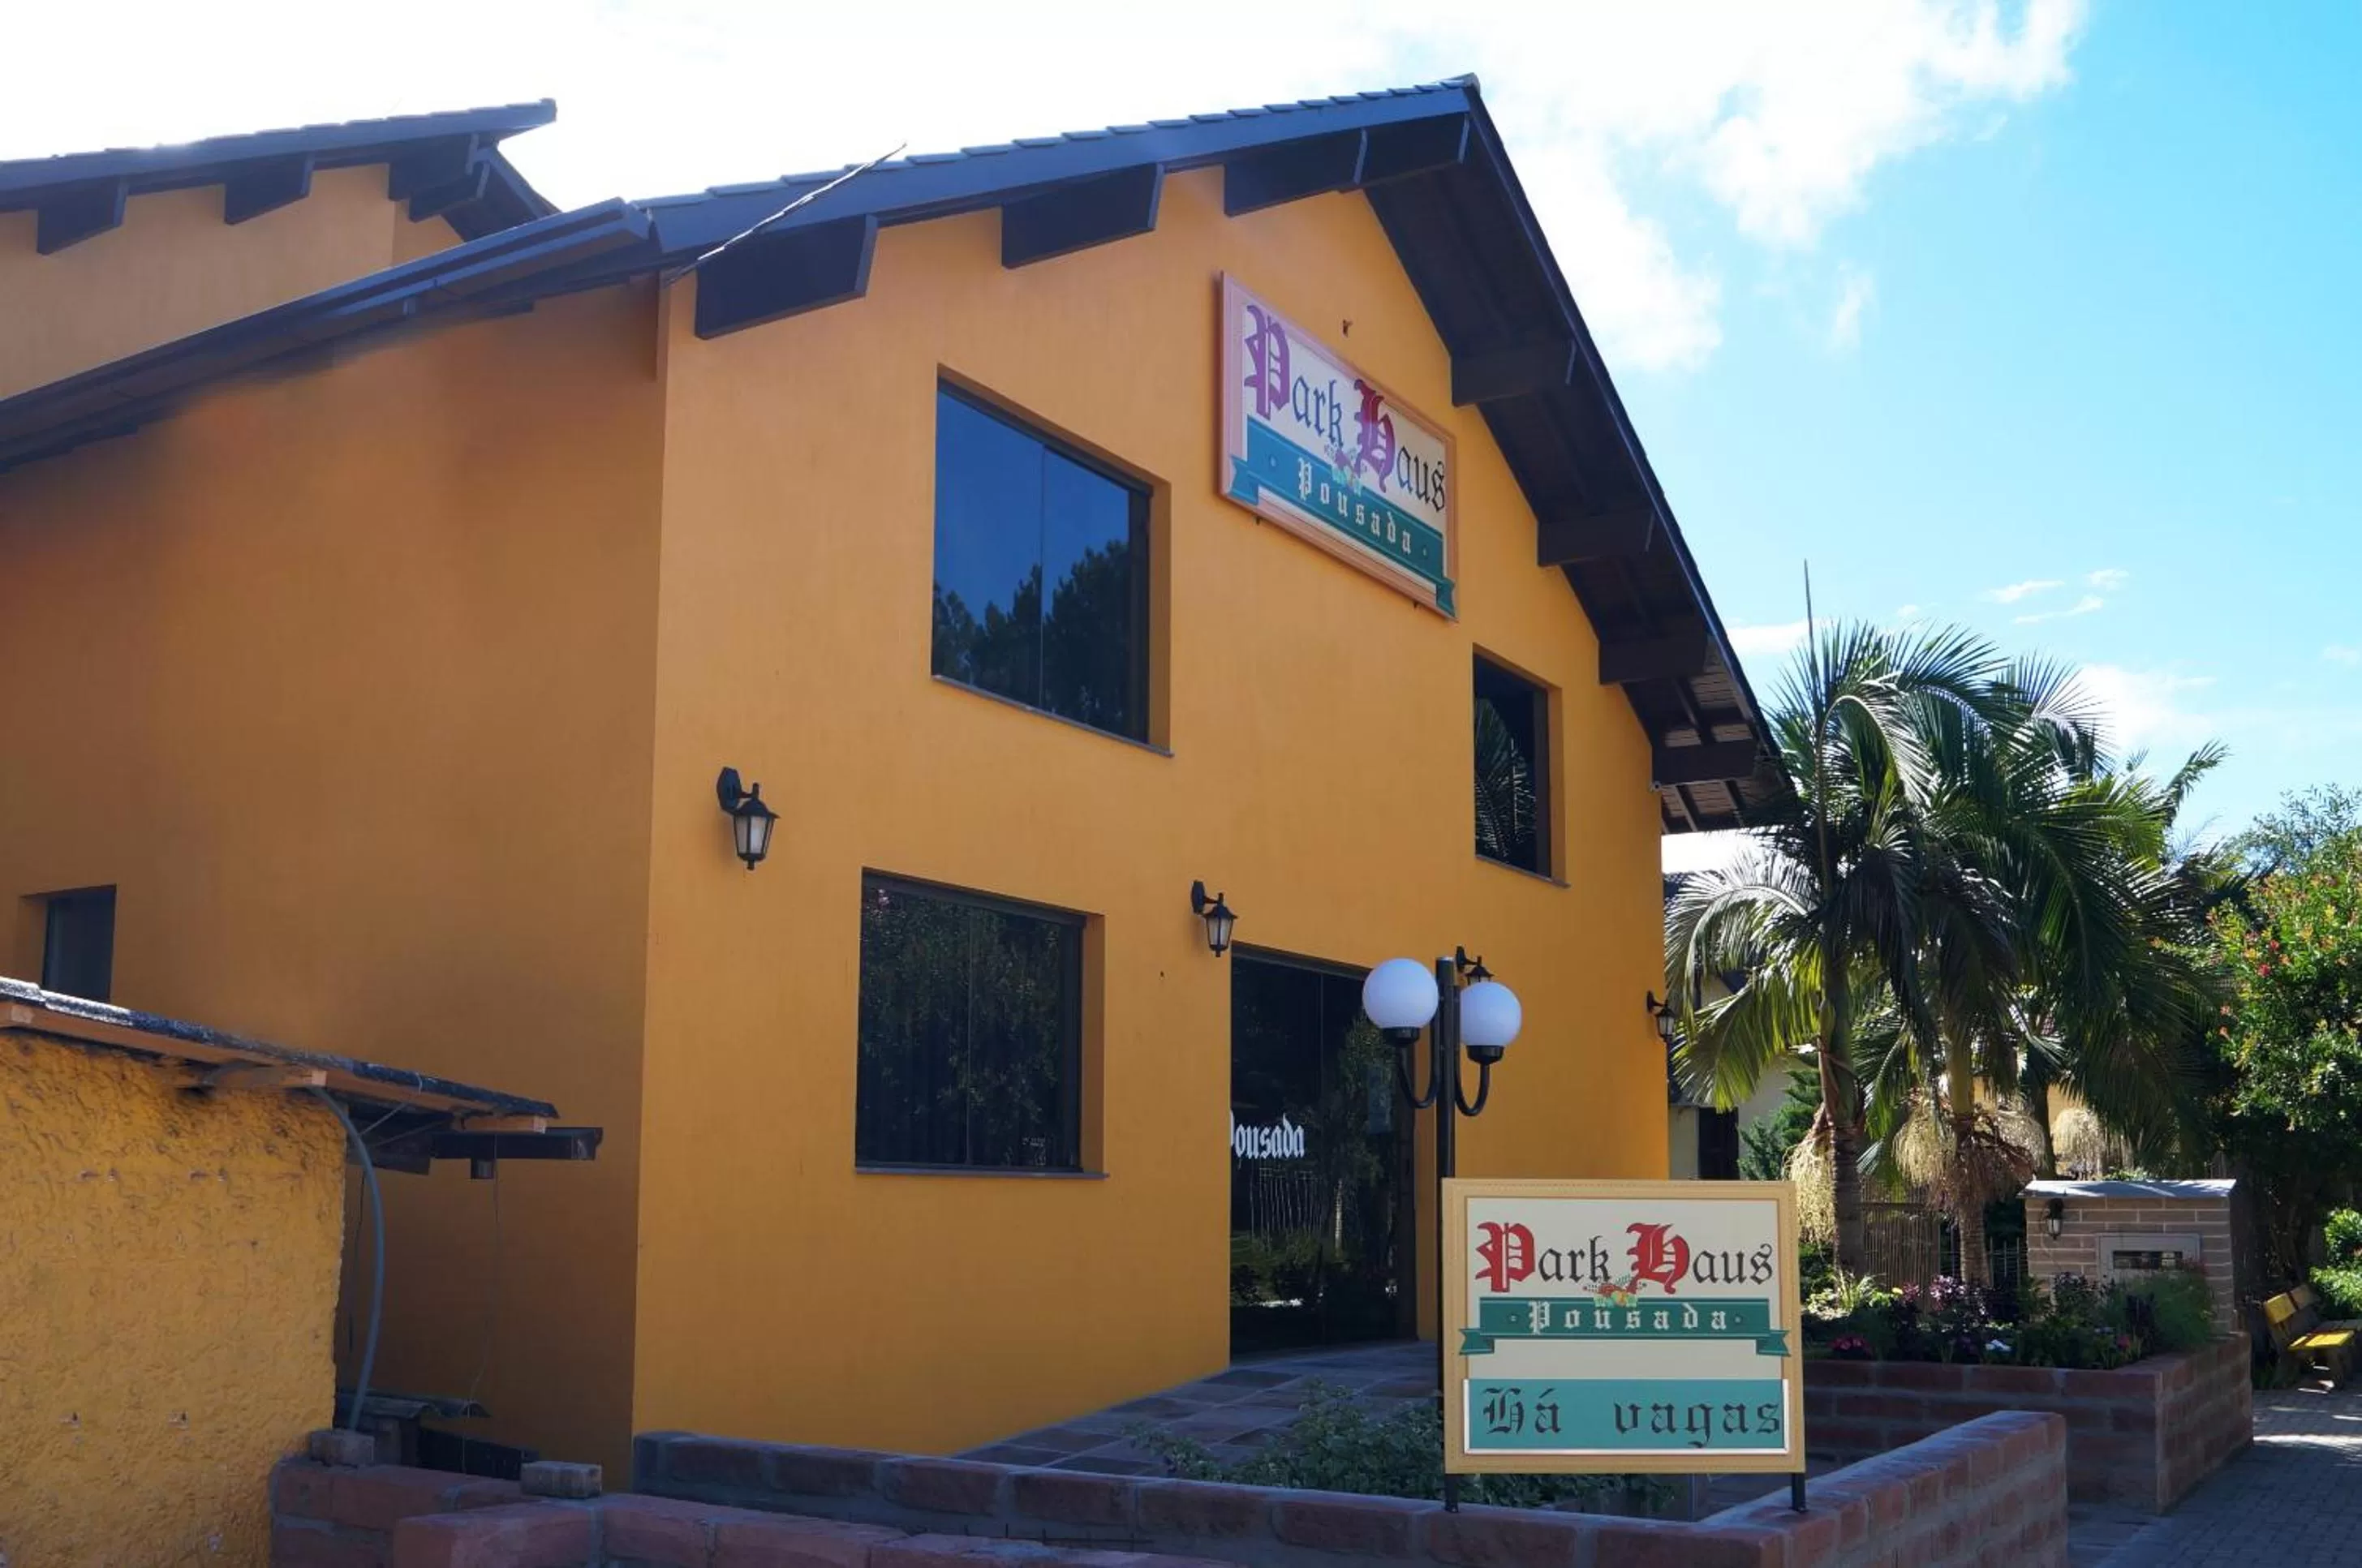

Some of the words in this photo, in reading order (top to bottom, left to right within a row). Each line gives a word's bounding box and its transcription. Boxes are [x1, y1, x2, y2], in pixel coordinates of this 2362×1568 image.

[1244, 305, 1344, 448] Park
[1354, 379, 1445, 512] Haus
[1298, 457, 1412, 554] Pousada
[1475, 1222, 1612, 1293] Park
[1626, 1222, 1774, 1295] Haus
[1529, 1300, 1727, 1334] Pousada
[1482, 1387, 1562, 1435] Há
[1613, 1400, 1781, 1449] vagas
